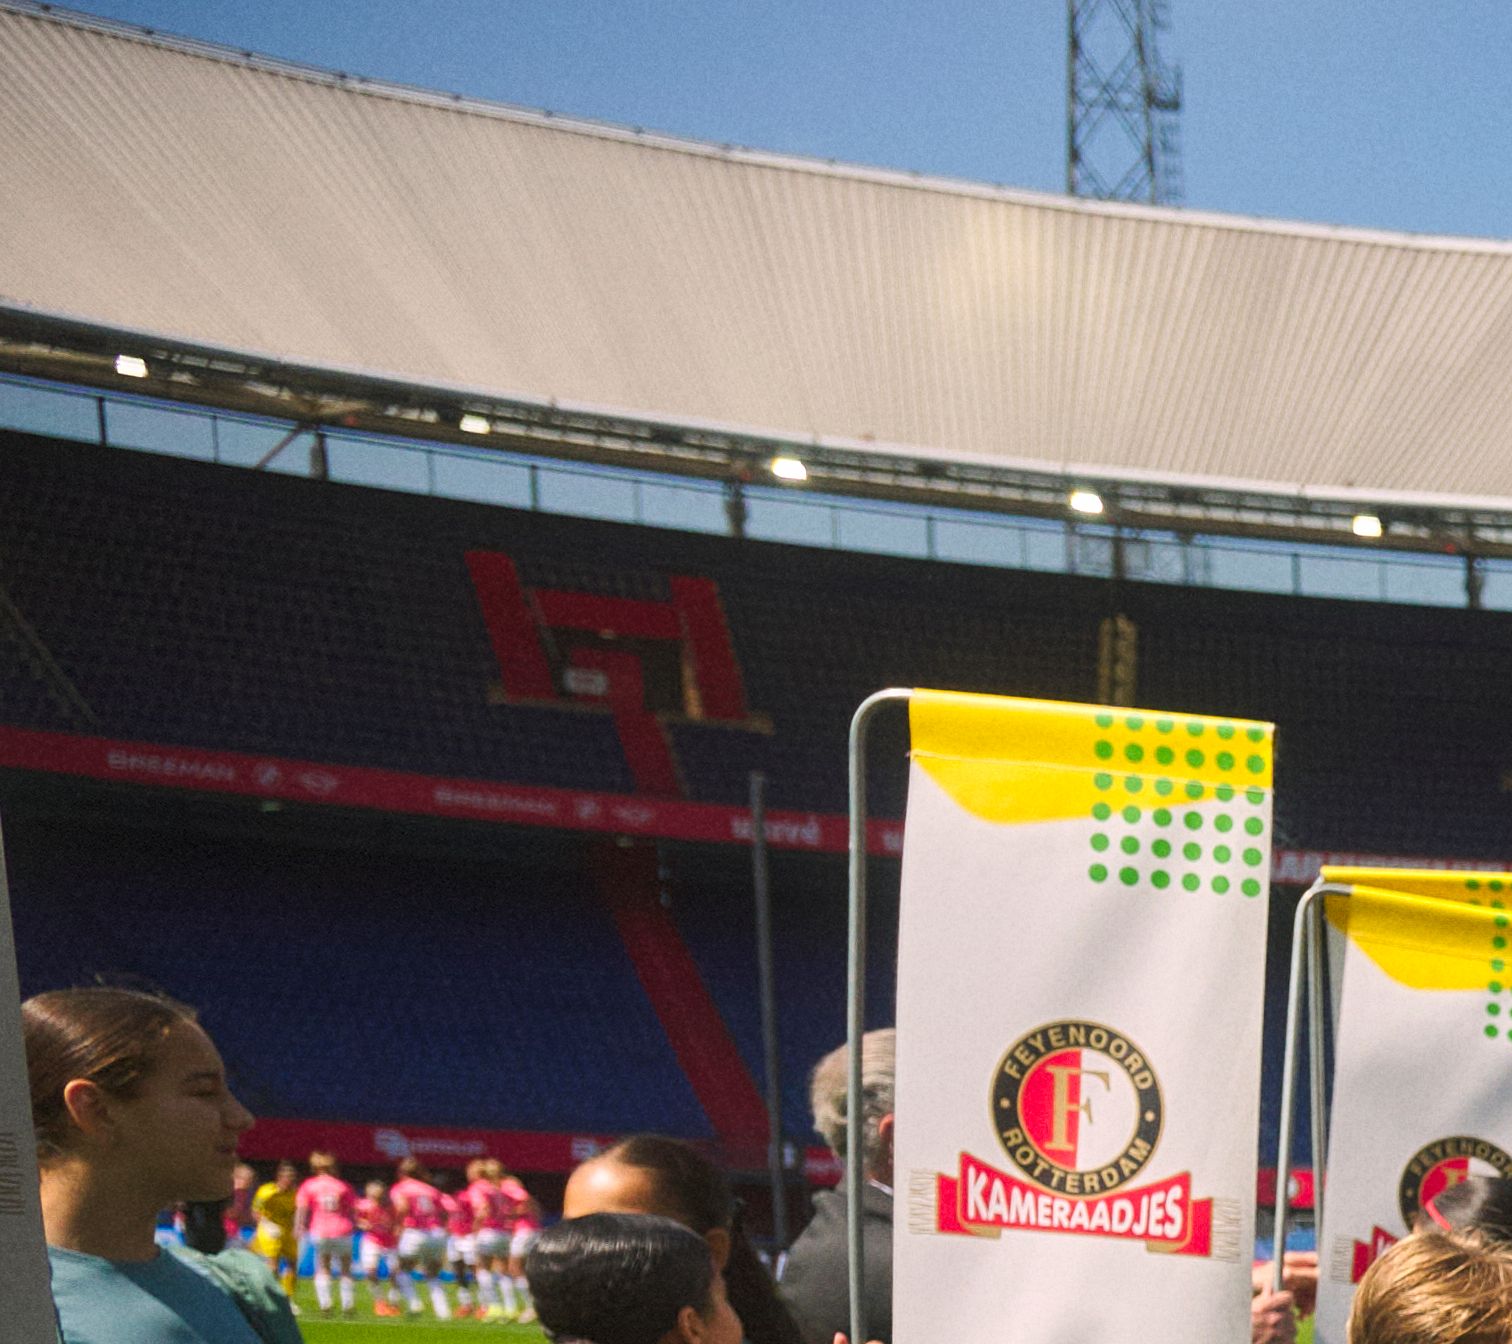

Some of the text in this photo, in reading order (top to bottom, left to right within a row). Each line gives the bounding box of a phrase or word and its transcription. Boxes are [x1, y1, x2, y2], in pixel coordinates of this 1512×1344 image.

[1004, 1023, 1153, 1091] FEYENOORD
[1002, 1127, 1152, 1195] ROTTERDAM
[967, 1164, 1183, 1239] KAMERAADJES
